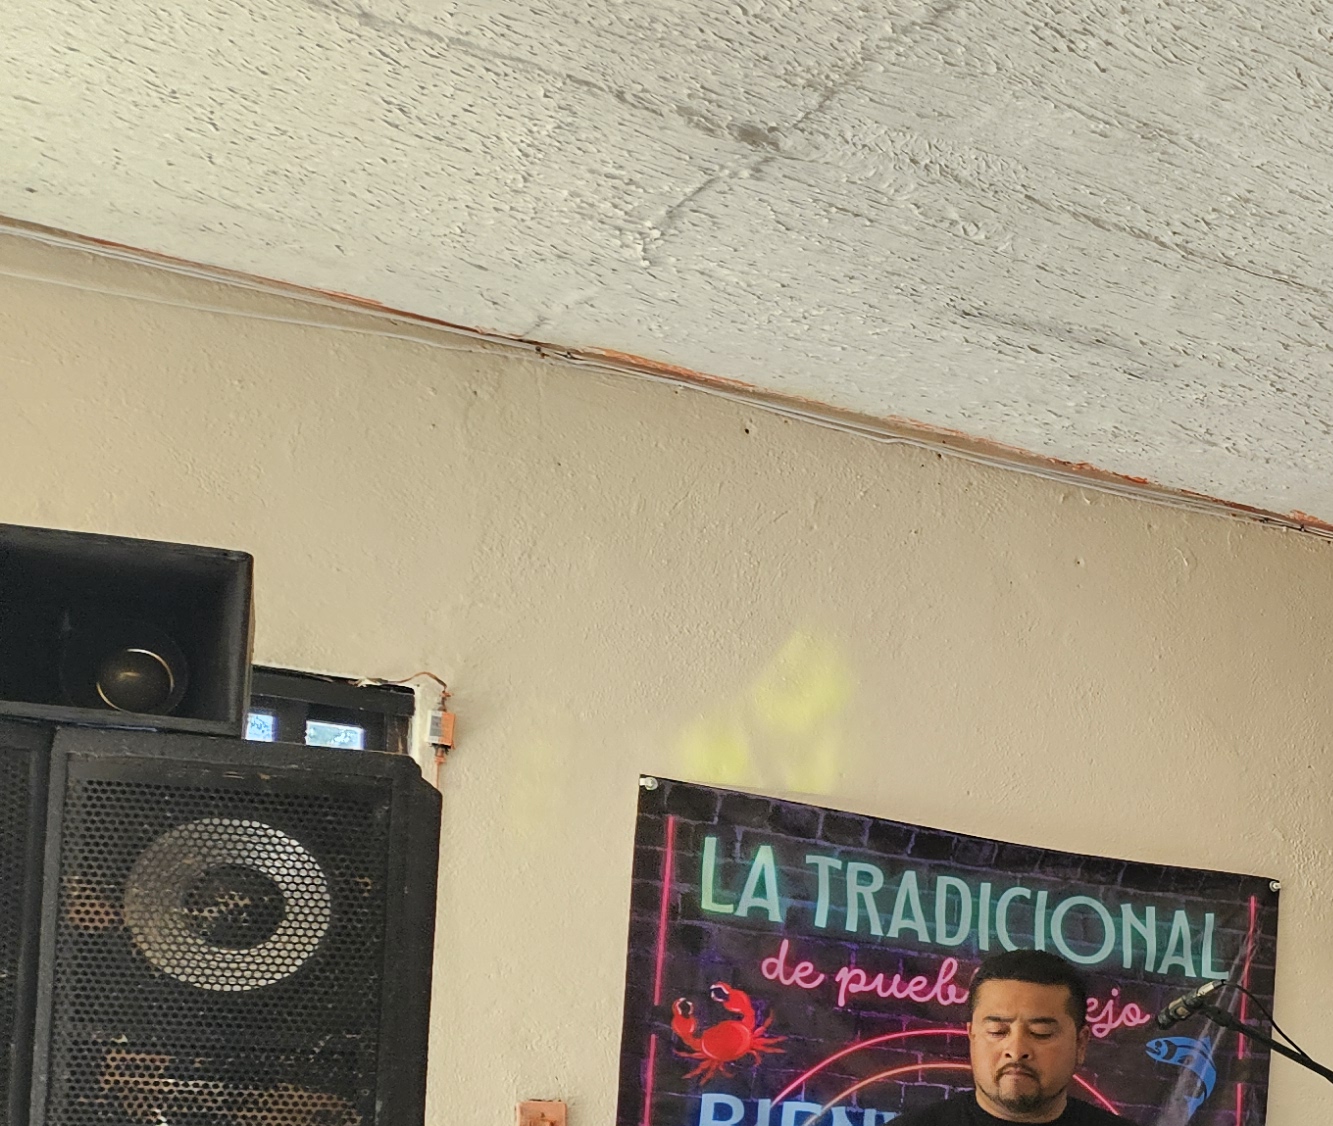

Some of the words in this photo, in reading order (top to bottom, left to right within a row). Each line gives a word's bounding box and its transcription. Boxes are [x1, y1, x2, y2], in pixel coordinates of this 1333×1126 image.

[701, 836, 783, 923] LA
[805, 854, 1230, 980] TRADICIONAL
[760, 939, 826, 989] de
[835, 957, 980, 1007] pueb
[1085, 987, 1151, 1039] ejo
